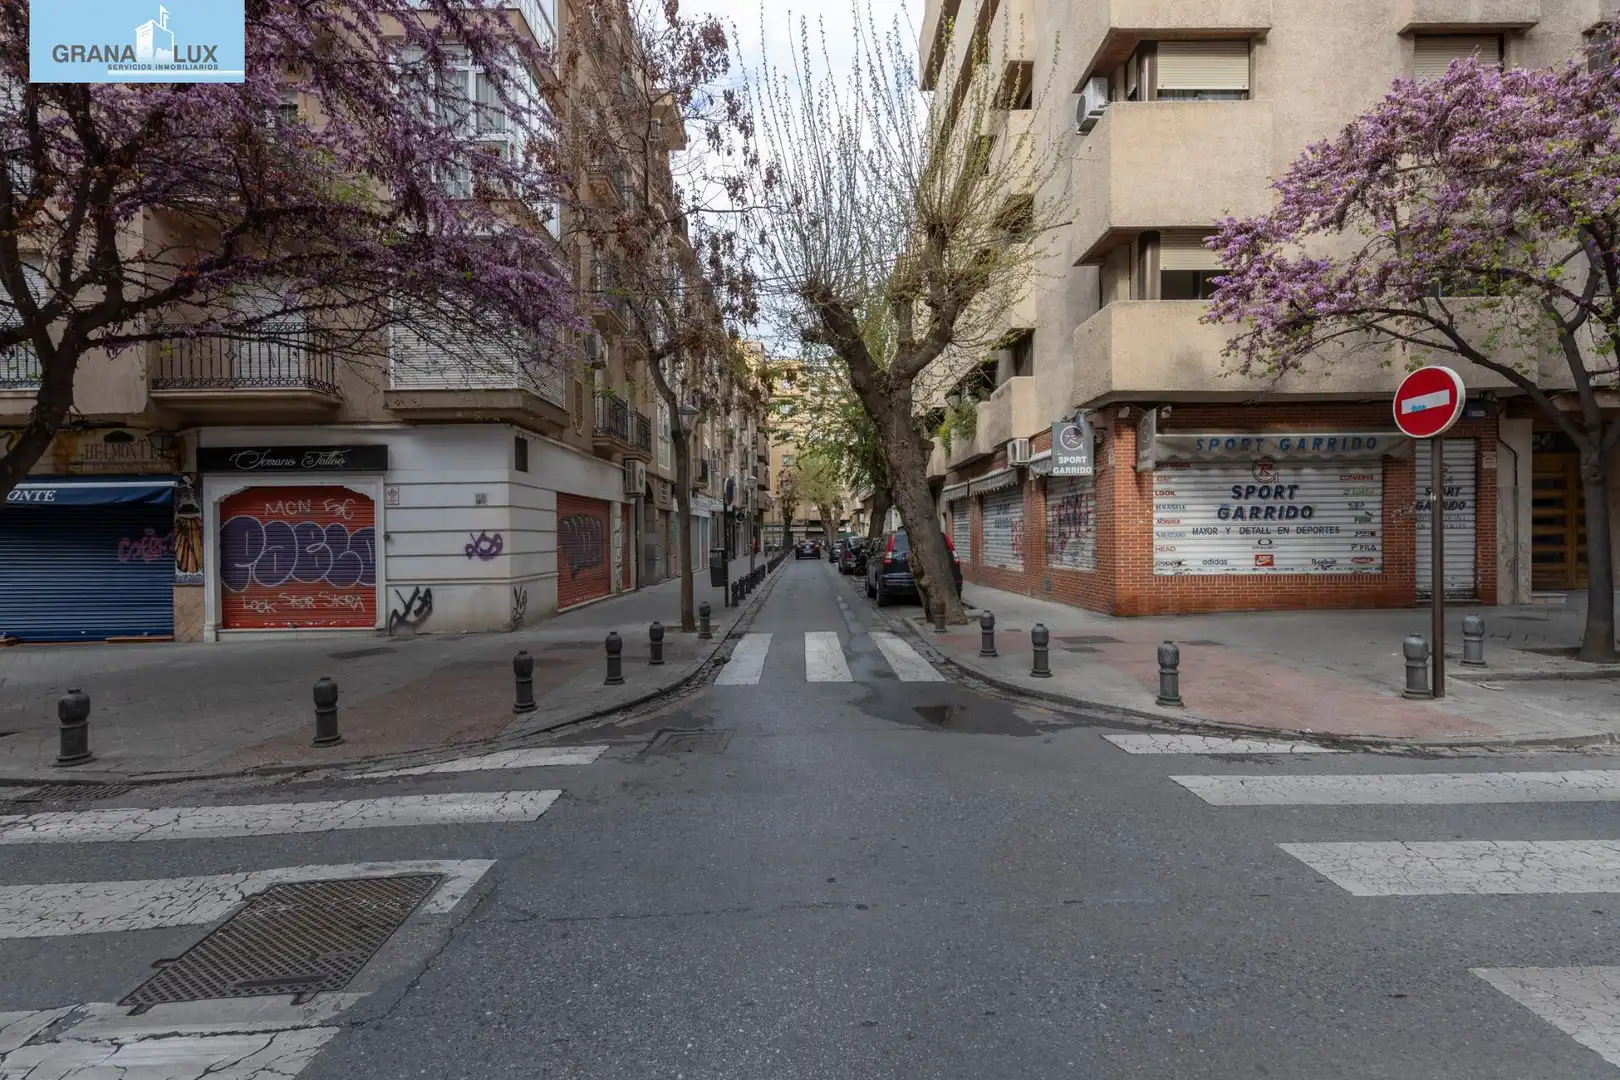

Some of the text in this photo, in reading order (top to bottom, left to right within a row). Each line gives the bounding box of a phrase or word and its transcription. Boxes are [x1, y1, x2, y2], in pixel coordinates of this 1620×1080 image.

[1195, 436, 1378, 452] SPORT GARRIDO
[229, 448, 352, 470] Serrano Tattoo
[1058, 456, 1087, 464] SPORT
[1053, 466, 1092, 474] GARRIDO
[1231, 484, 1300, 500] SPORT
[1217, 505, 1314, 521] GARRIDO
[1192, 526, 1340, 535] MAYOR Y DETALL EN DEPORTES
[1202, 558, 1228, 566] adidas
[1311, 558, 1337, 566] Reebok
